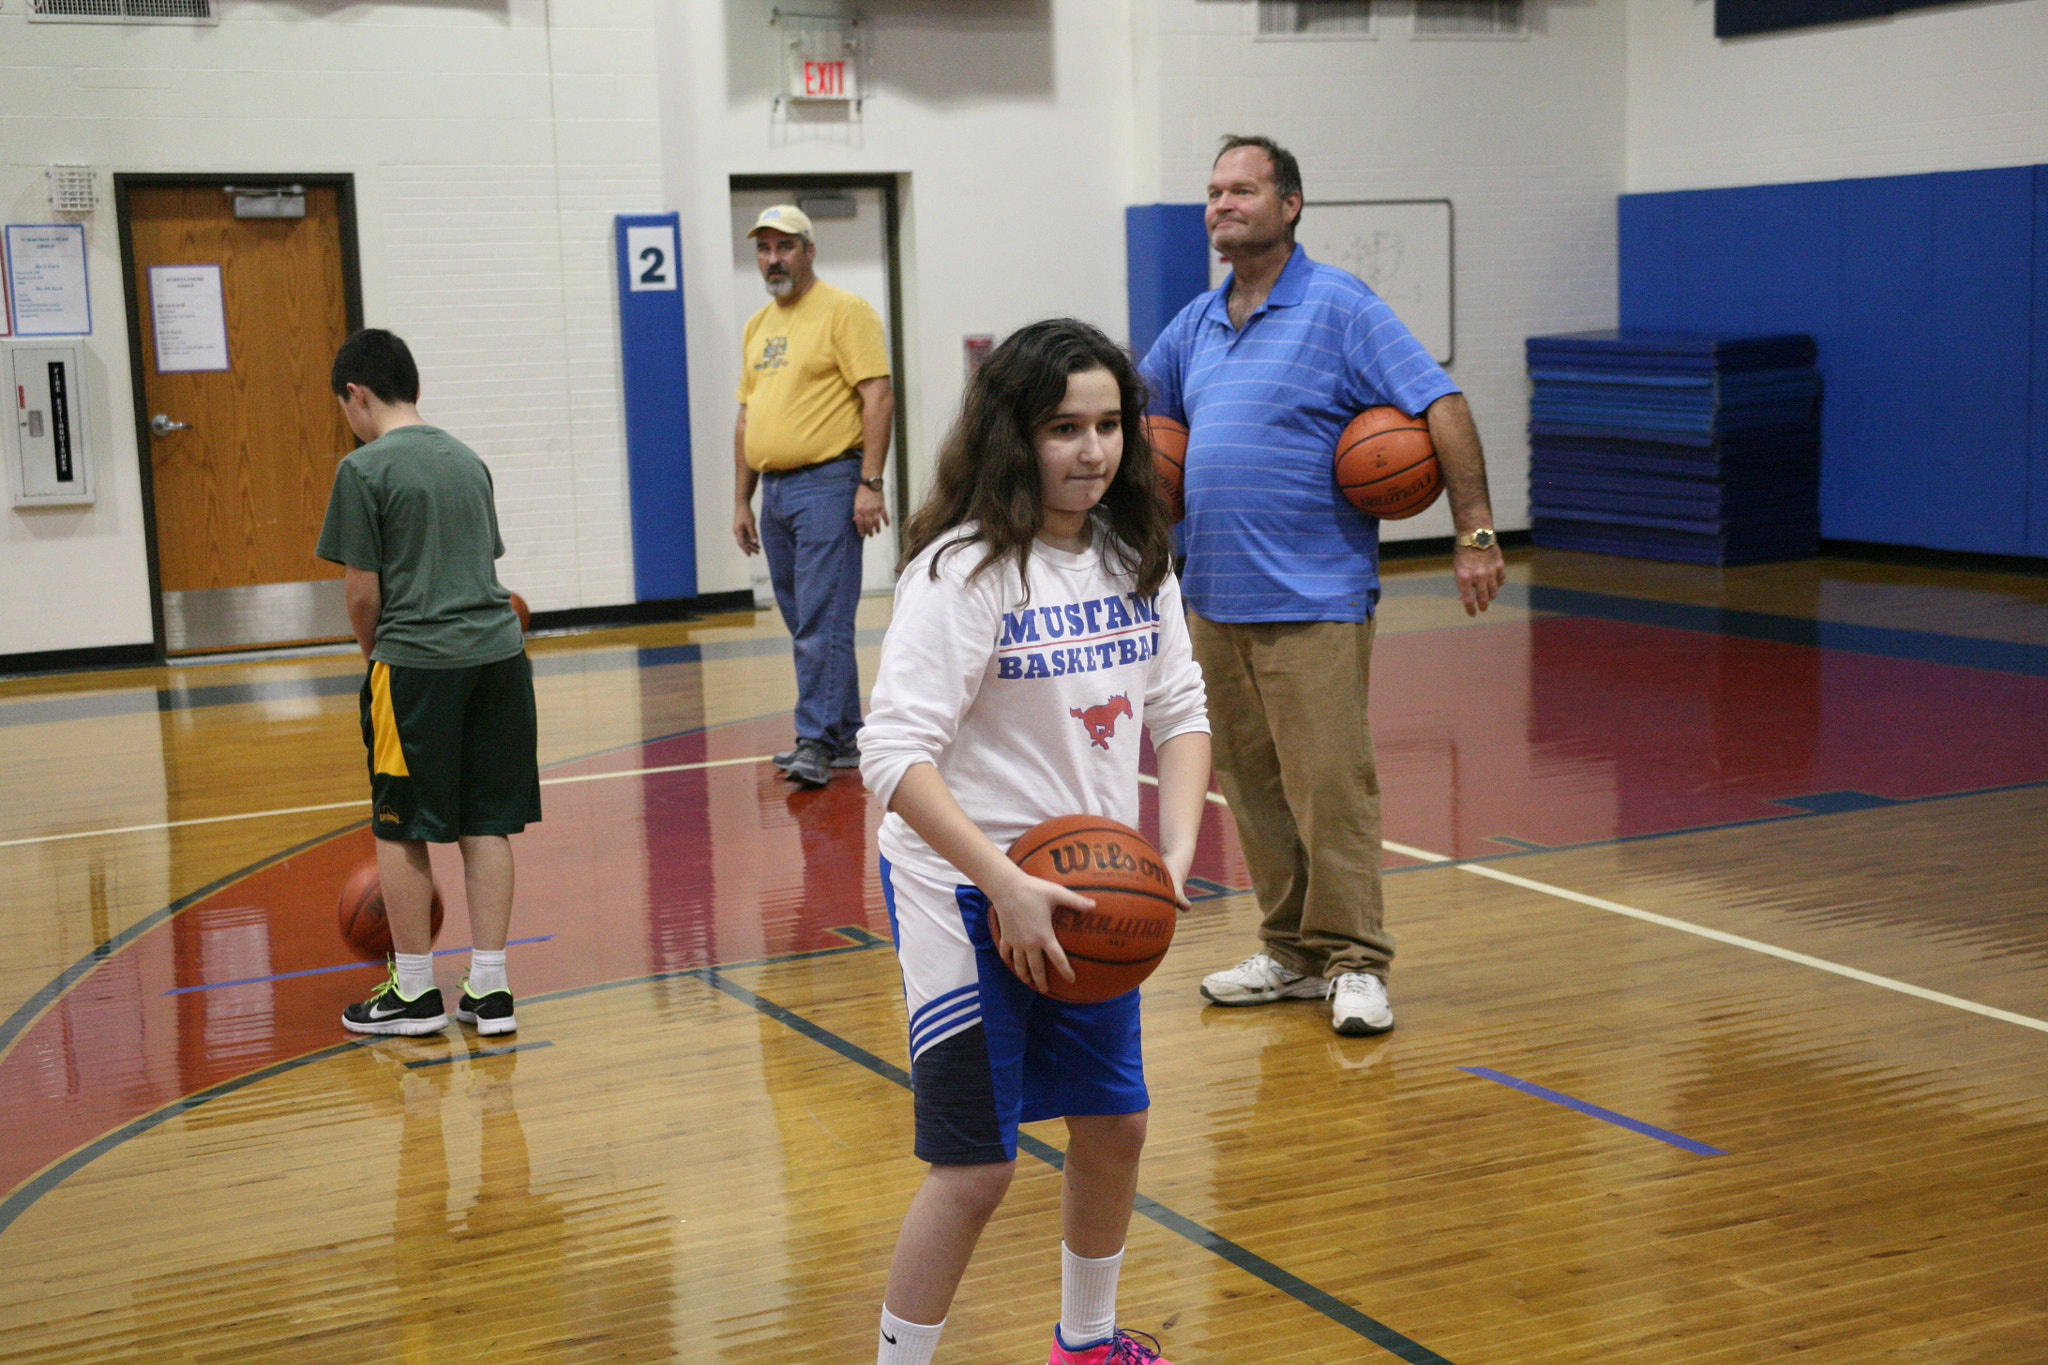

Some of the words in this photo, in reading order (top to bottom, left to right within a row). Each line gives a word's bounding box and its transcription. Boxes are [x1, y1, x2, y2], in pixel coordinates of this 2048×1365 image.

[804, 61, 845, 95] EXIT
[640, 247, 665, 283] 2
[1049, 841, 1168, 888] Wilson
